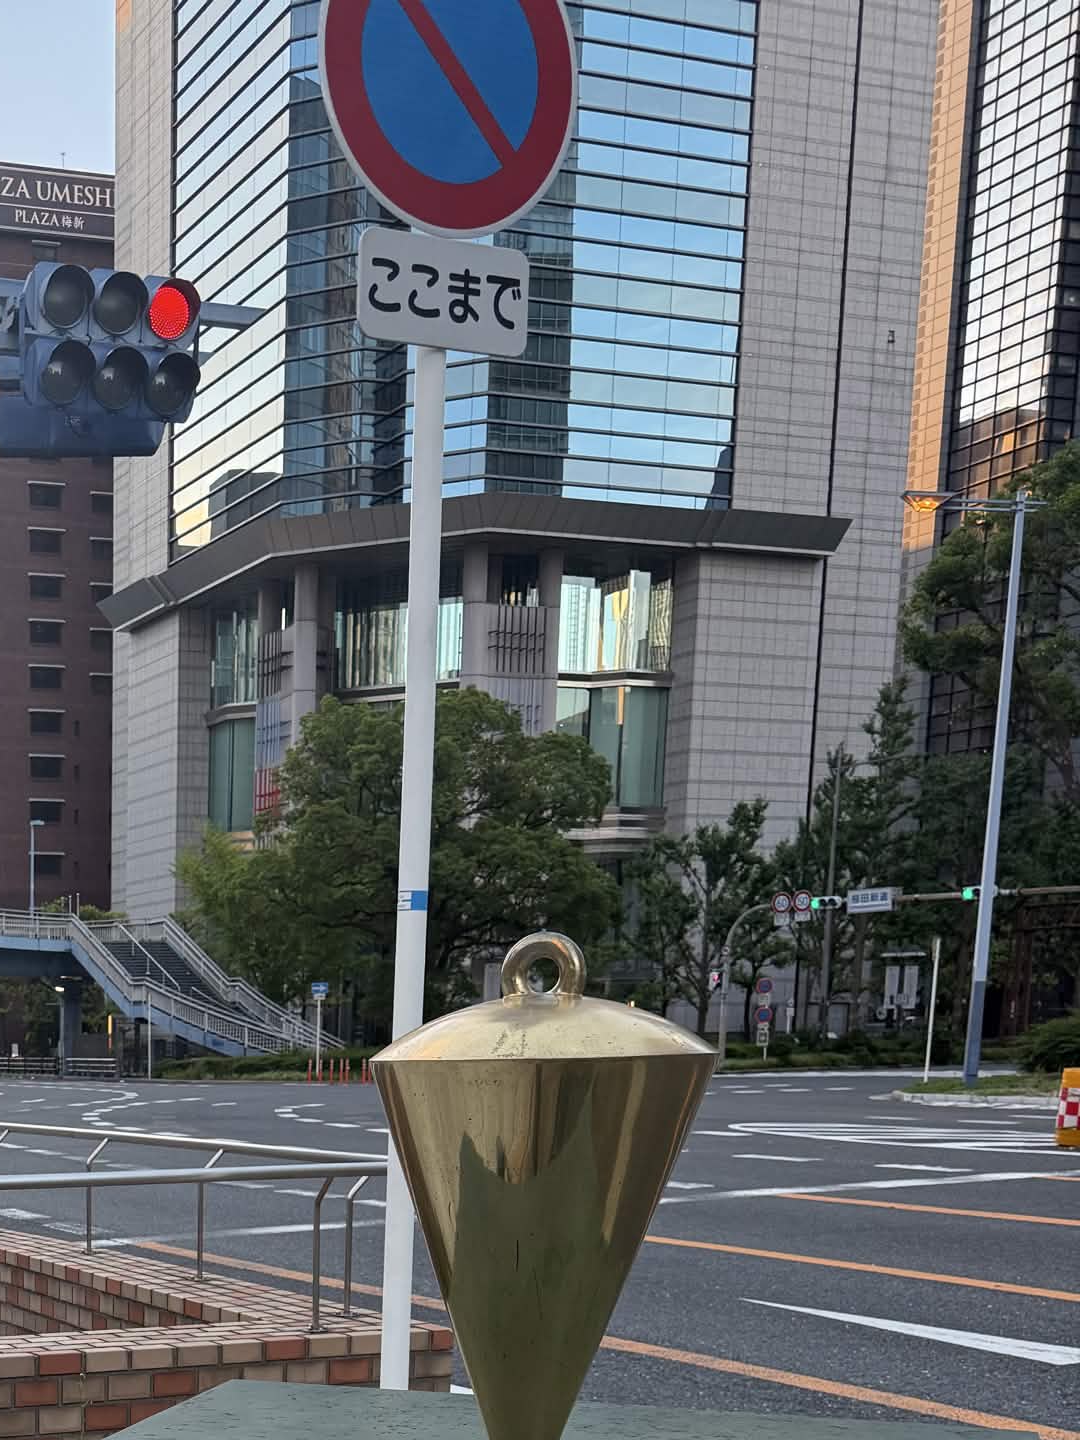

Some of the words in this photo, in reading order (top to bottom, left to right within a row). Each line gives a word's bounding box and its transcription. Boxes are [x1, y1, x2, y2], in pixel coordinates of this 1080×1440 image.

[36, 180, 112, 208] UMESH
[15, 208, 59, 227] PLAZA
[368, 257, 522, 330] ここまで
